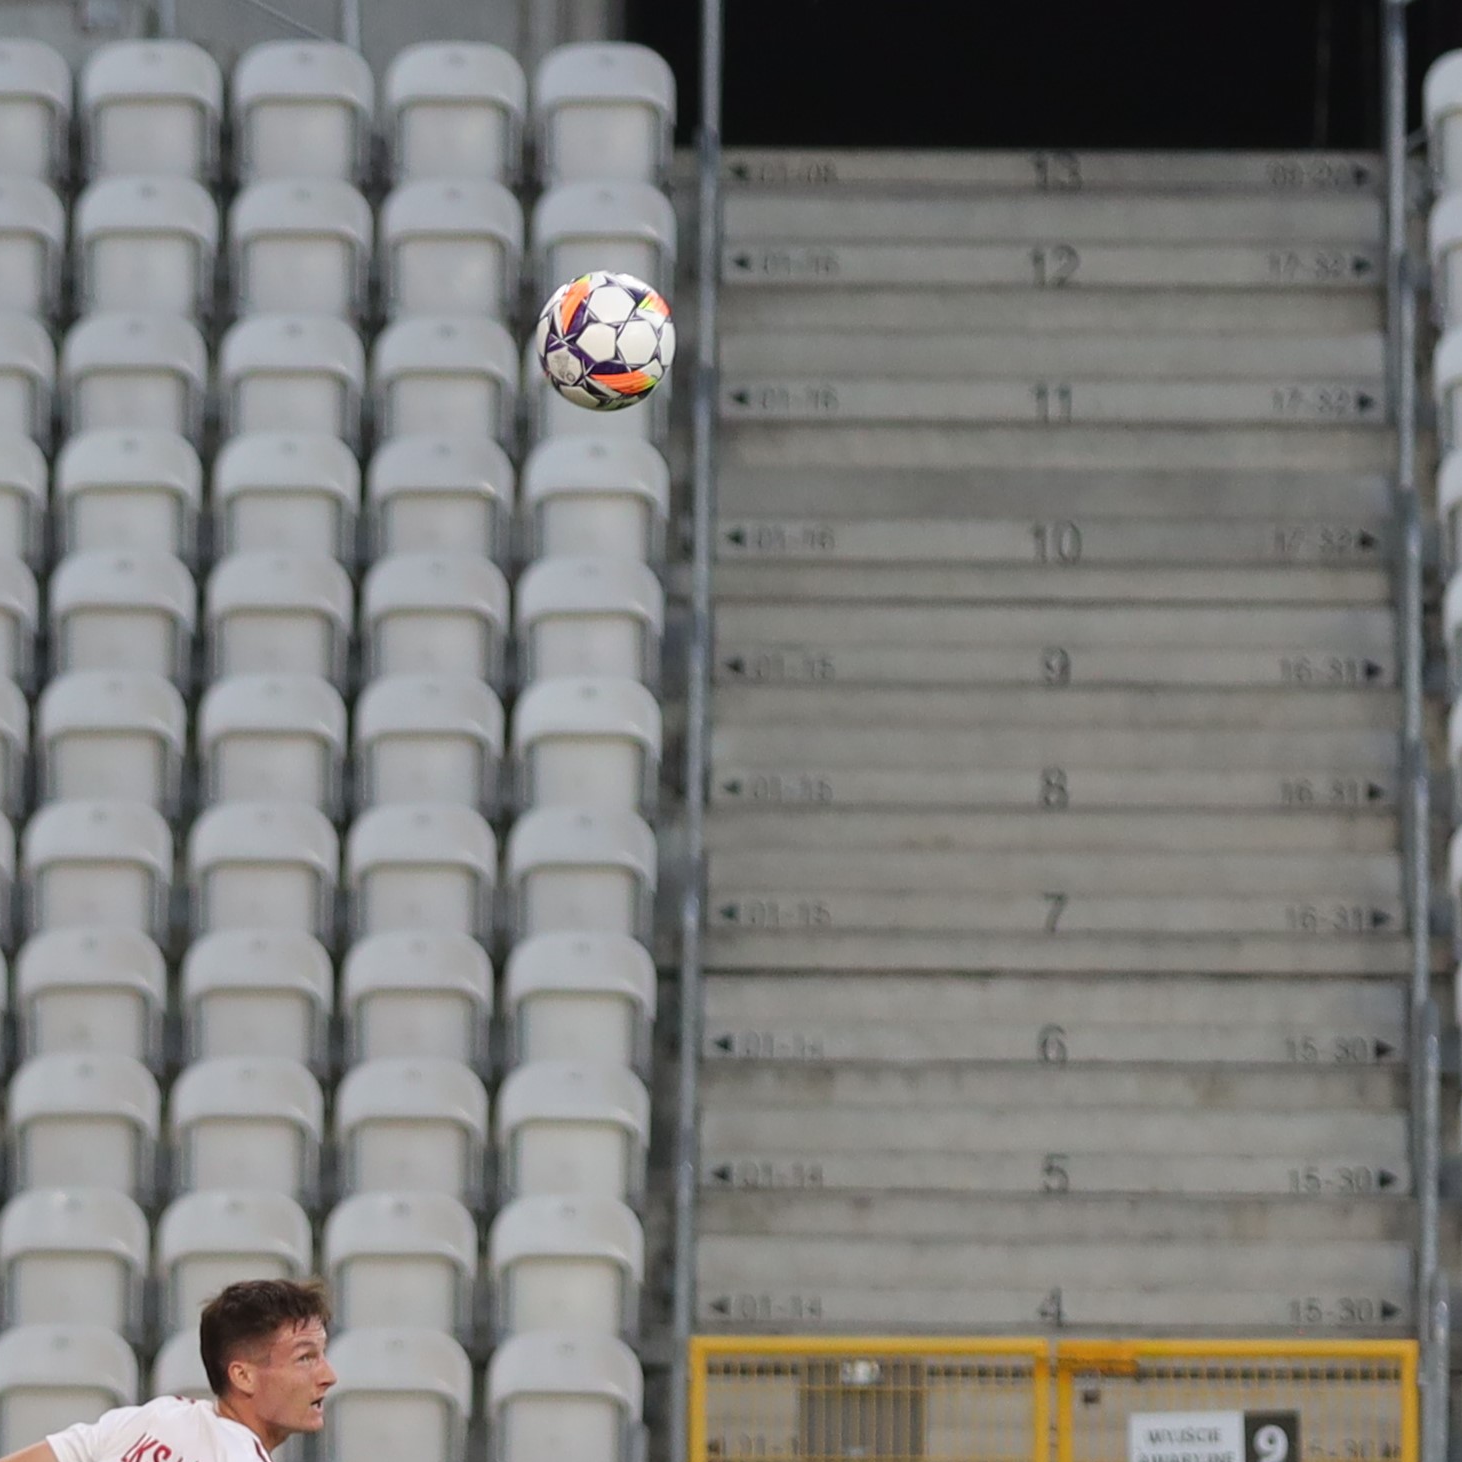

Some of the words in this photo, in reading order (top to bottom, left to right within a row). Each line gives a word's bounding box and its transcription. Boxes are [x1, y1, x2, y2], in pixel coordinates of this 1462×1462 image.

[1031, 245, 1081, 288] 12
[1034, 382, 1073, 424] 11
[1033, 520, 1082, 565] 10
[1042, 645, 1071, 688] 9
[1040, 765, 1070, 809] 8
[1042, 892, 1069, 934] 7
[1037, 1023, 1068, 1065] 6
[1042, 1153, 1070, 1194] 5
[1037, 1287, 1065, 1330] 4
